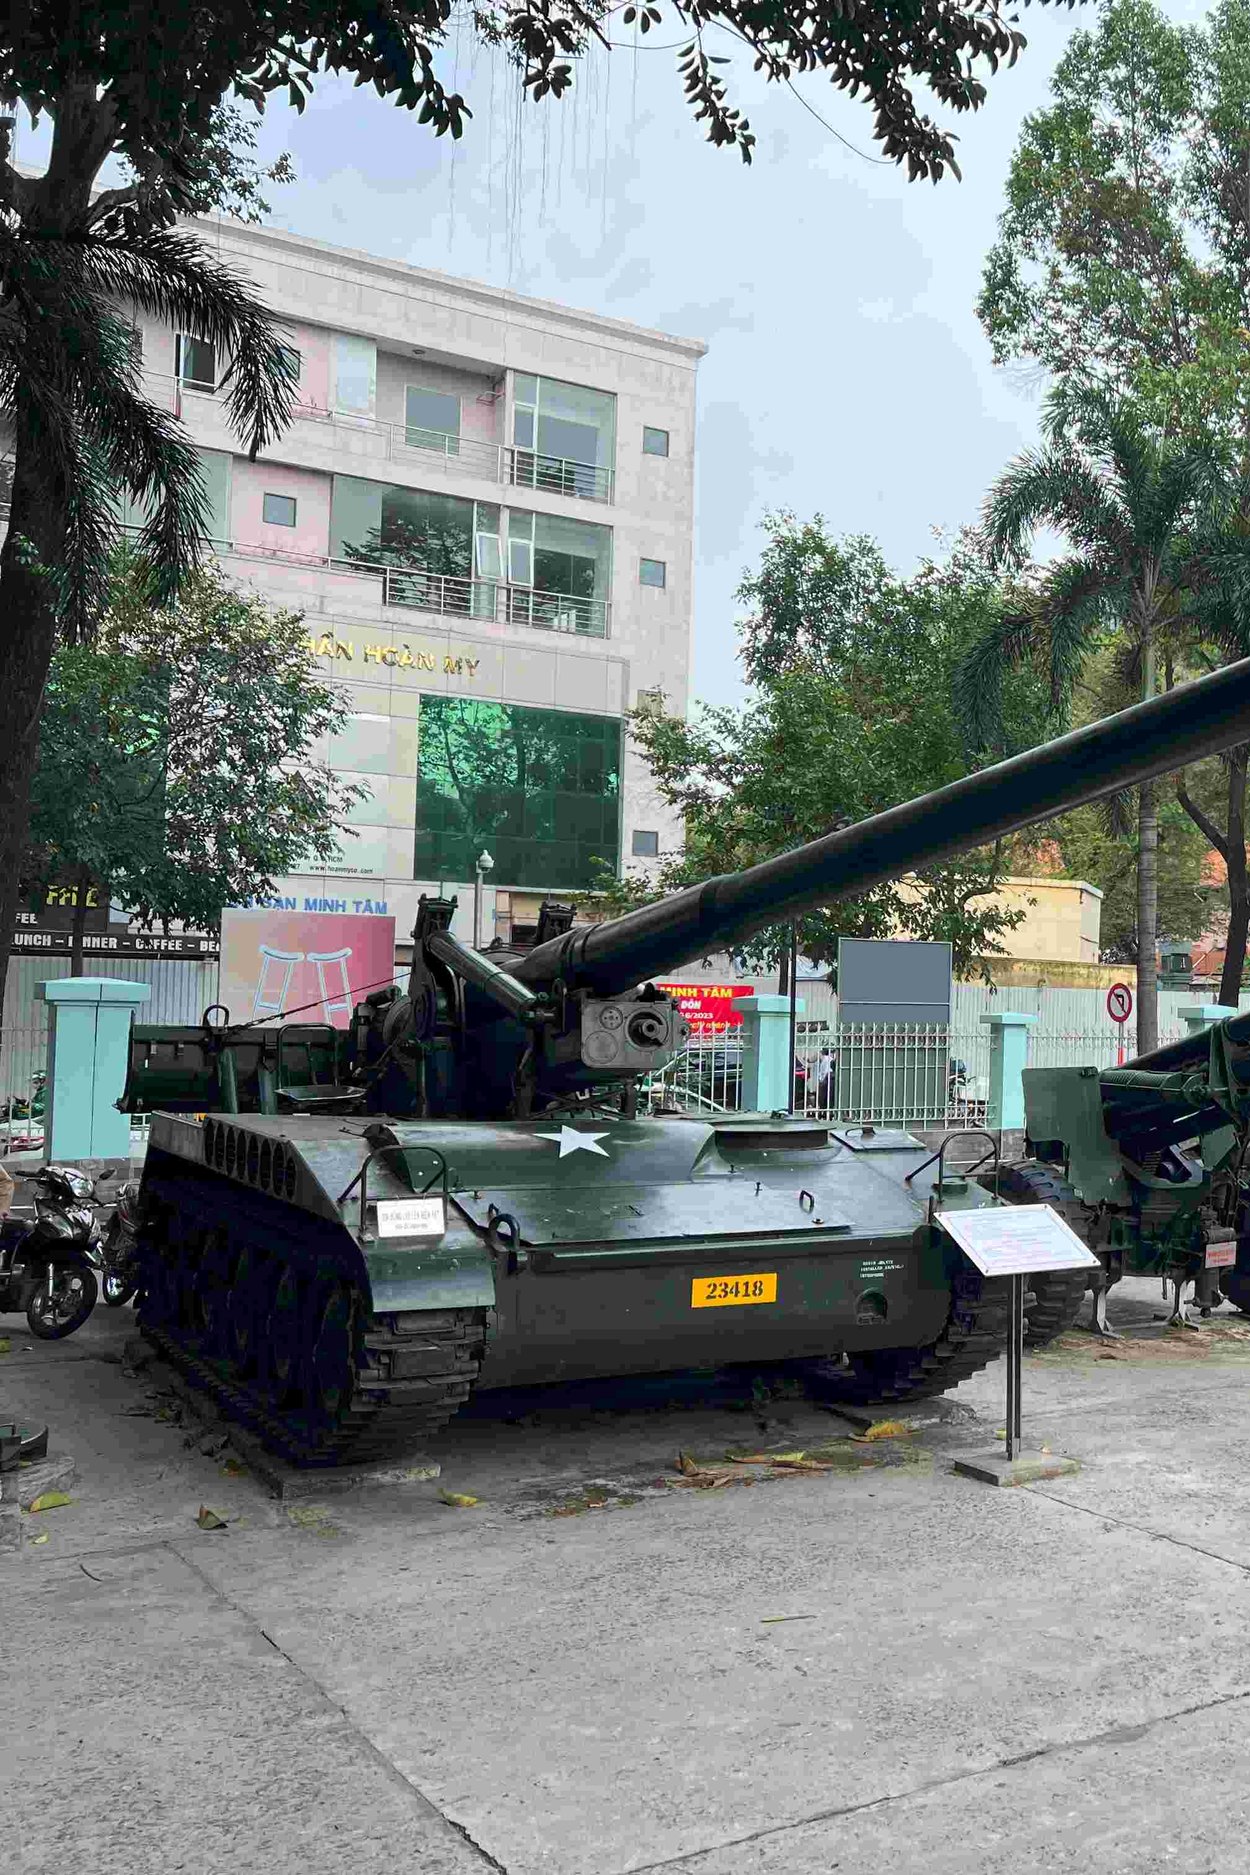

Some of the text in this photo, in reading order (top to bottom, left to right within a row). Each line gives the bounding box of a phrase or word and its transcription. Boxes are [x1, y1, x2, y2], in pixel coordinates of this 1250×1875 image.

[363, 643, 435, 671] HOÀN
[304, 897, 347, 913] MINH
[352, 898, 388, 914] TÂM
[12, 933, 52, 947] UNCH
[701, 986, 733, 998] TÂM
[705, 1280, 764, 1300] 23418
